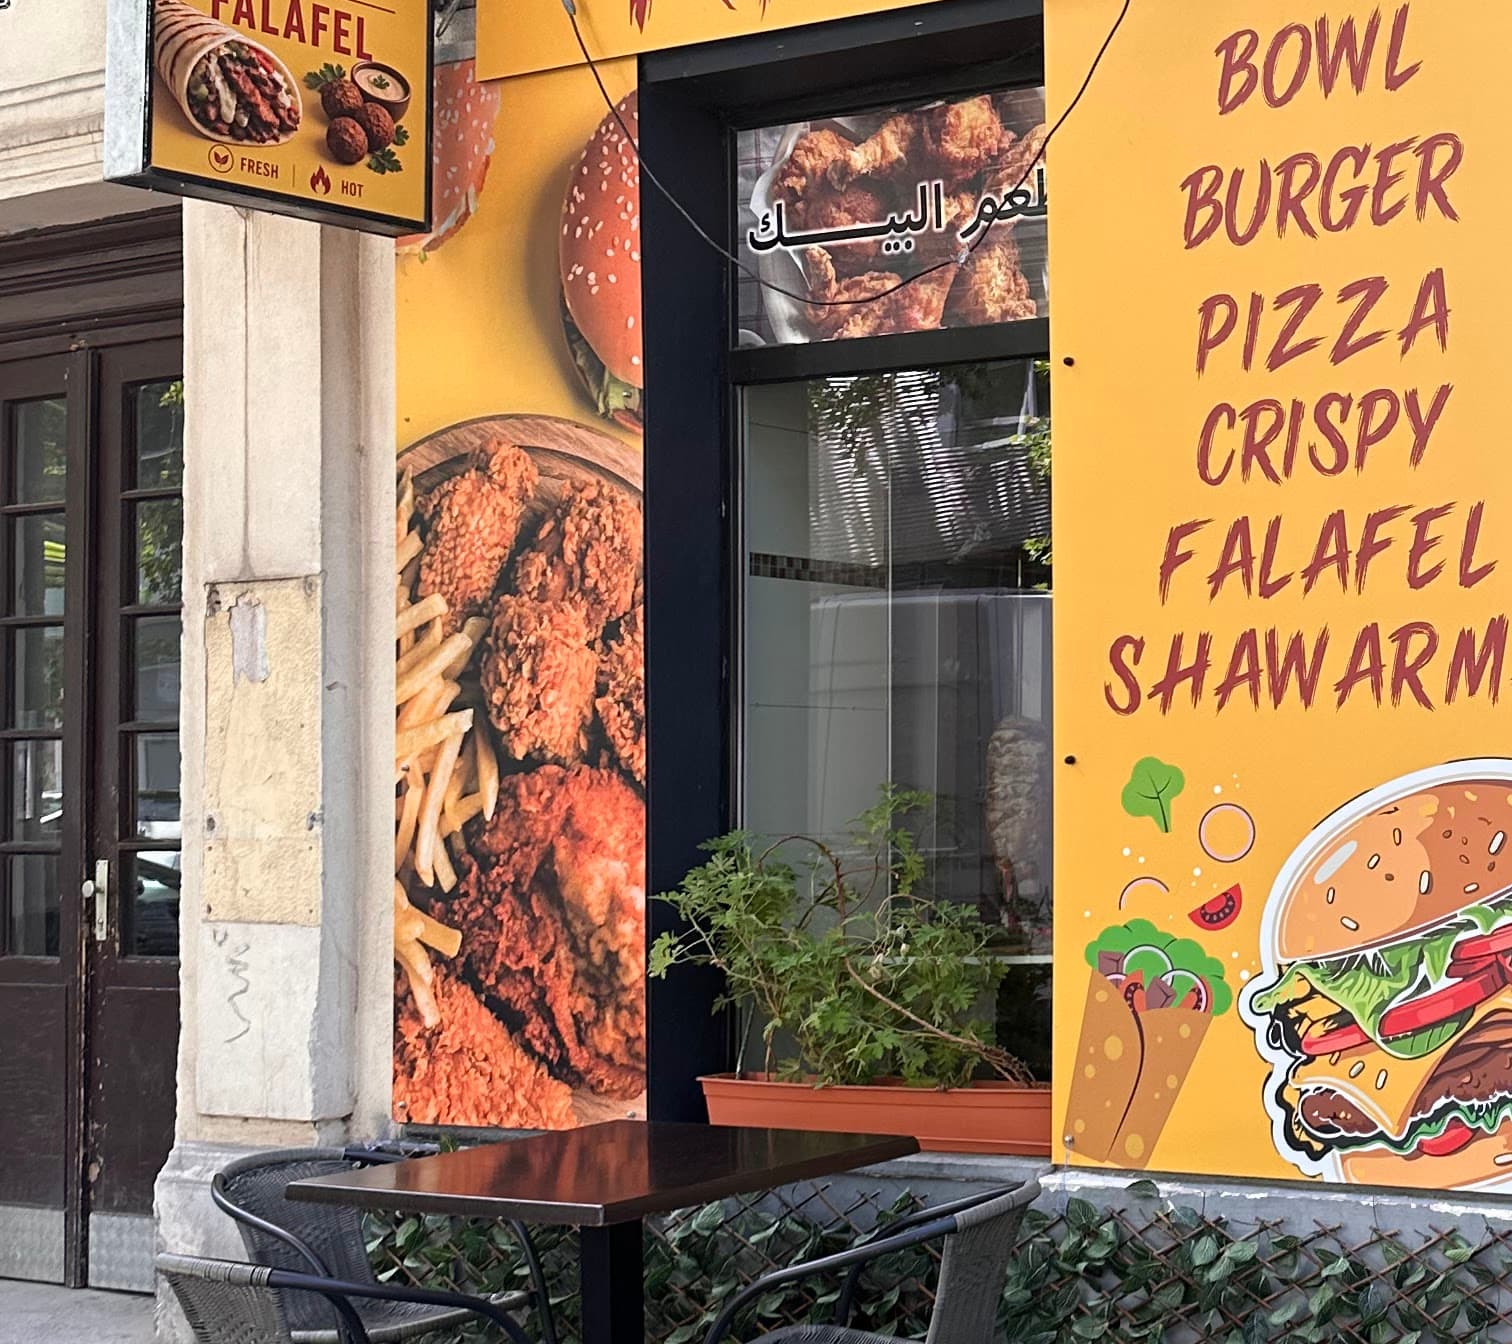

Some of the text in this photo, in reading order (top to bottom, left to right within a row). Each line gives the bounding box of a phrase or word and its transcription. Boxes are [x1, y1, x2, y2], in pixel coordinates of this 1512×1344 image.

[1215, 3, 1423, 116] BOWL
[240, 157, 364, 198] FRESH HOT
[1179, 133, 1464, 250] BURGER
[1195, 267, 1452, 378] PIZZA
[1196, 383, 1454, 487] CRISPY
[1158, 501, 1498, 607] FALAFEL
